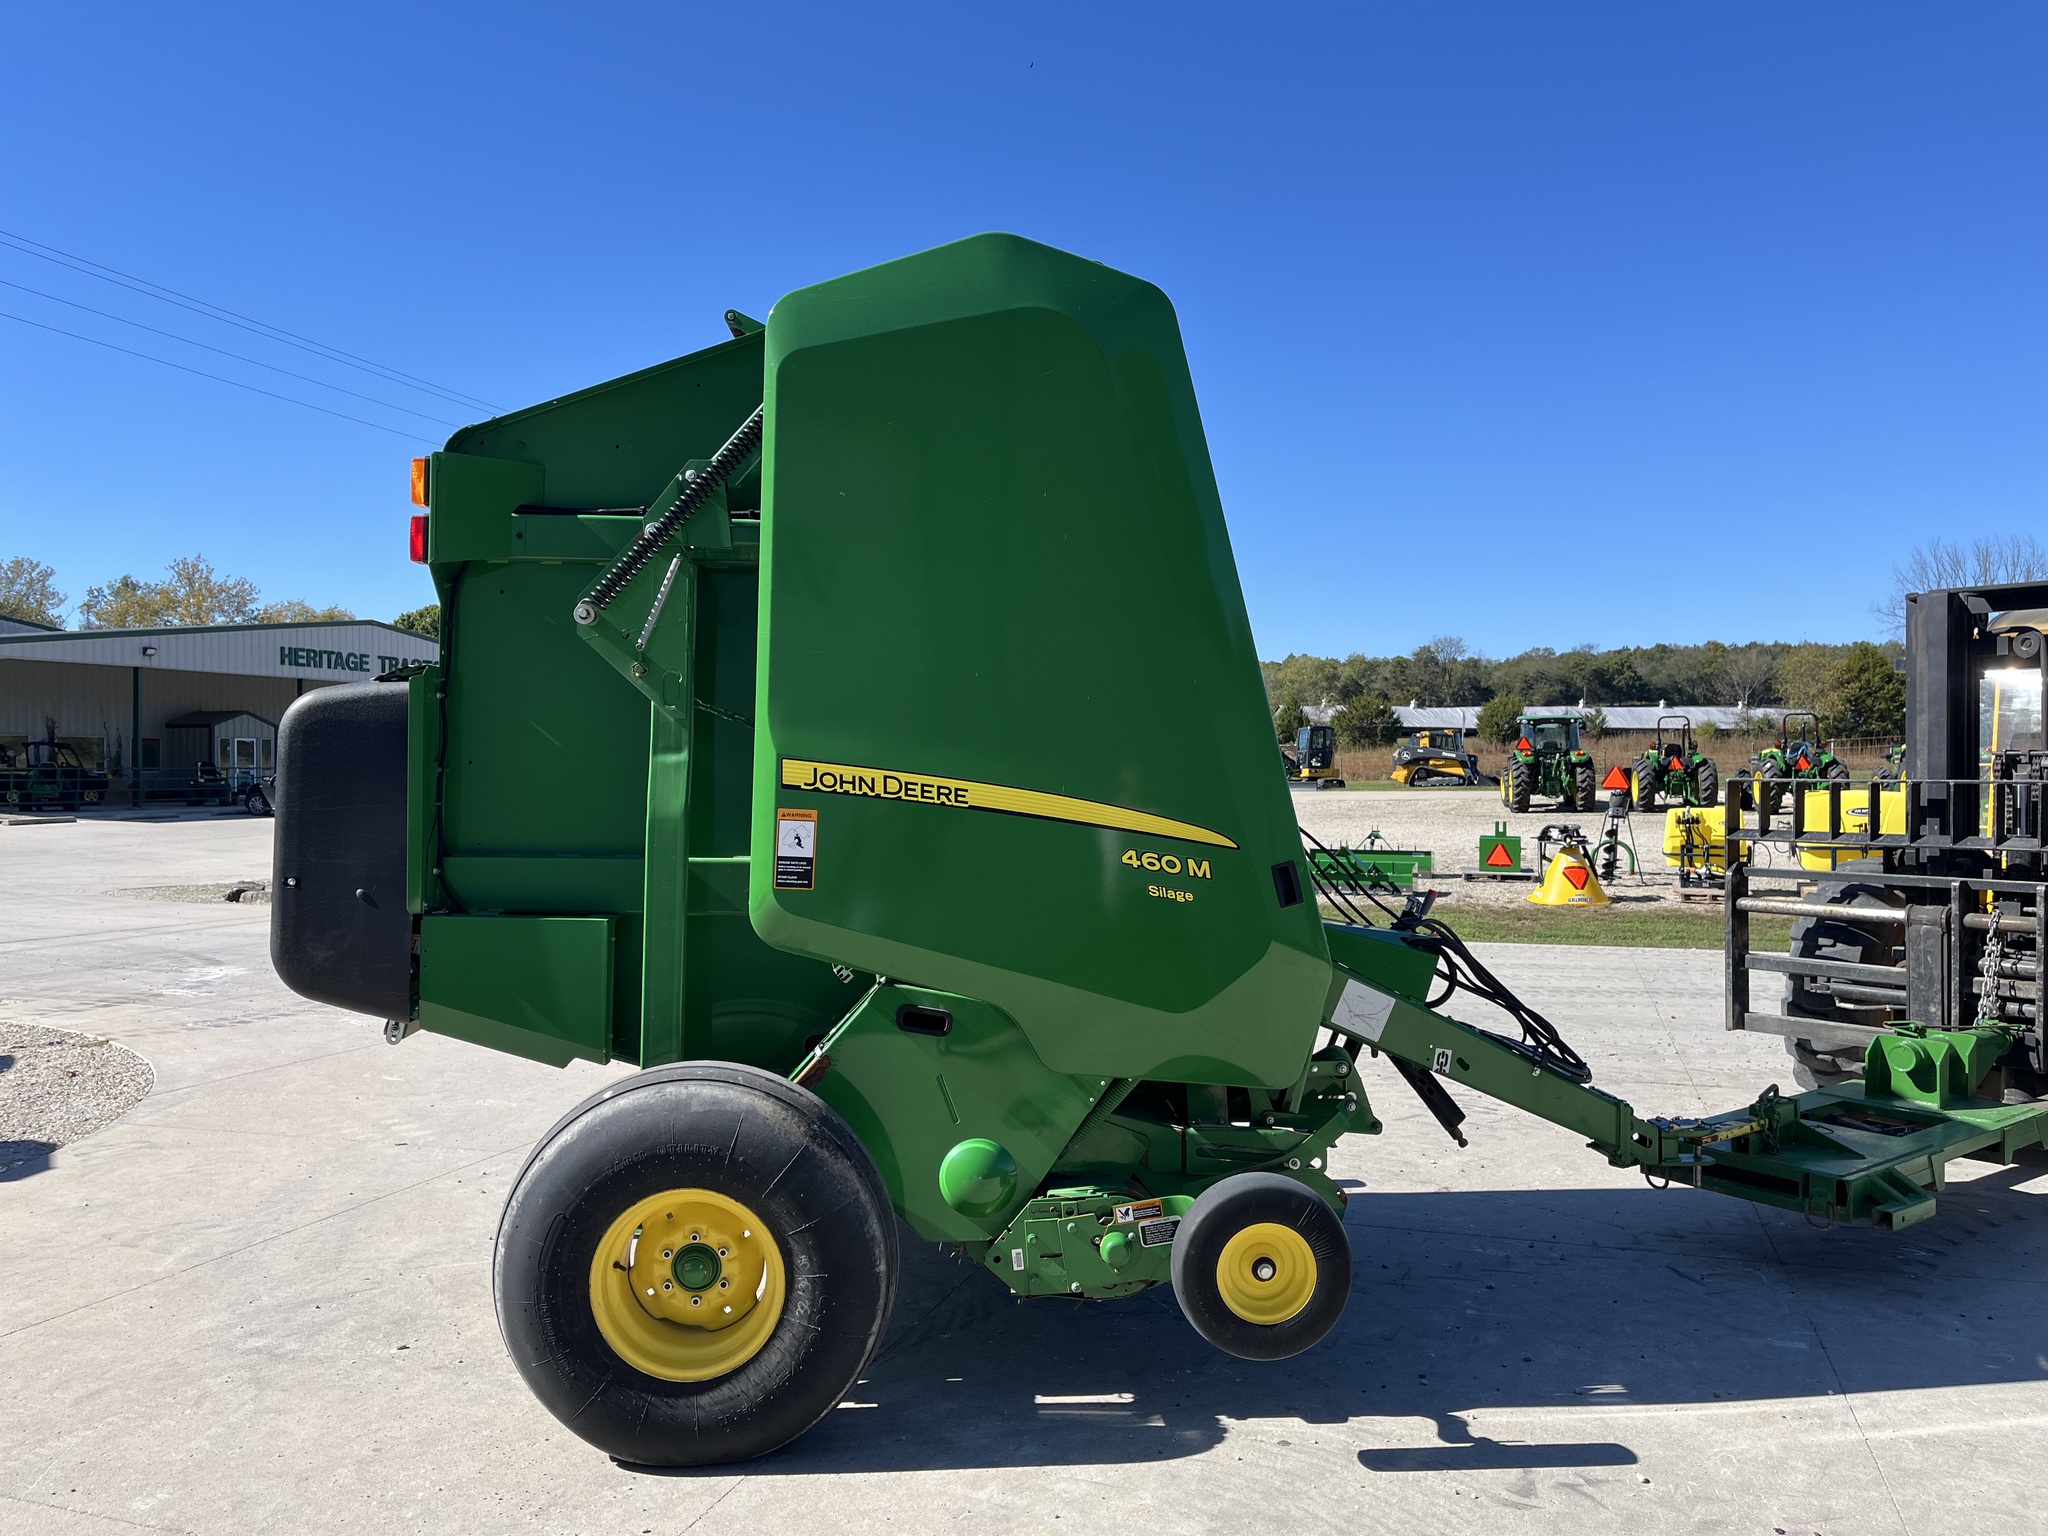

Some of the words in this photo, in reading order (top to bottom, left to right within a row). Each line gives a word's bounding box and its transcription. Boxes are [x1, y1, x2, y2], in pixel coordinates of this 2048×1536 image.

[280, 646, 370, 672] HERITAGE
[803, 767, 877, 794] JOHN
[883, 775, 970, 806] DEERE
[1120, 848, 1183, 876] 460
[1187, 858, 1213, 880] M
[1148, 883, 1195, 903] Silage
[606, 1150, 648, 1176] FARM
[656, 1143, 720, 1156] UTILITY
